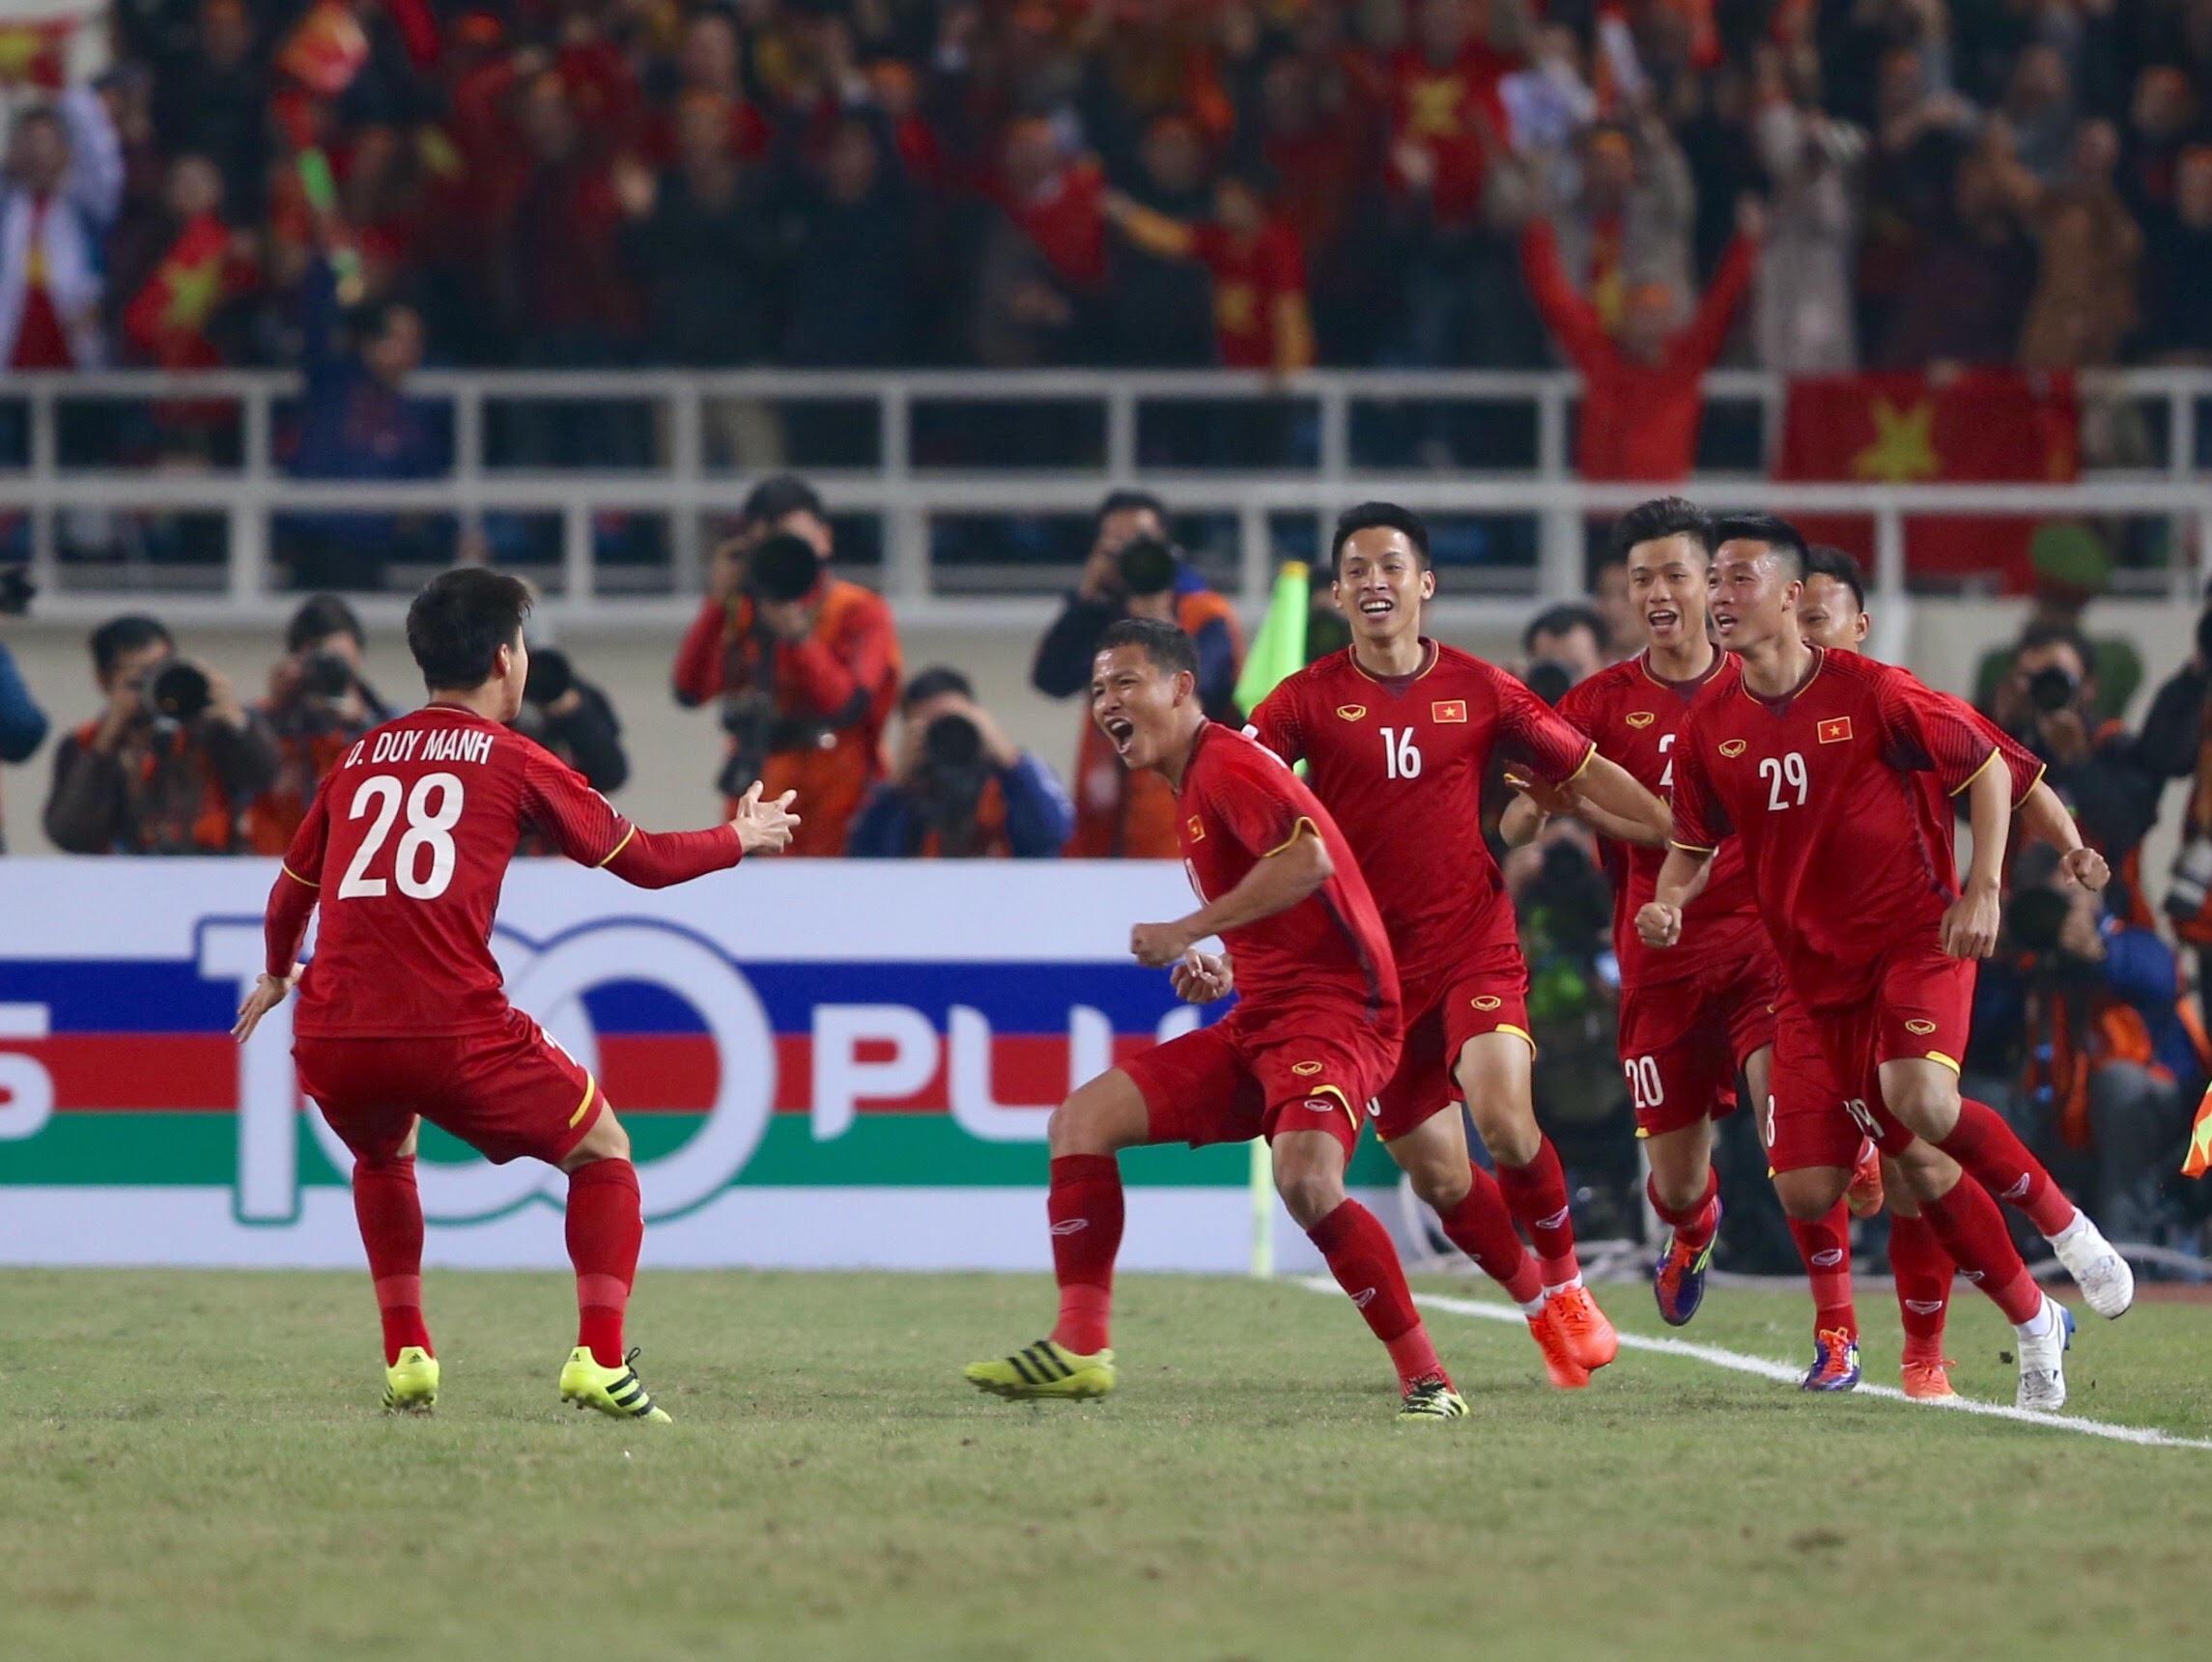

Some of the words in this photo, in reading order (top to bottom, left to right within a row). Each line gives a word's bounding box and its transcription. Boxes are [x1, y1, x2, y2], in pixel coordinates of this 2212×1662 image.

[371, 730, 423, 764] DUY
[420, 728, 494, 765] MANH
[1379, 727, 1421, 779] 16
[1759, 752, 1808, 811] 29
[338, 773, 464, 900] 28
[1625, 1056, 1664, 1108] 20
